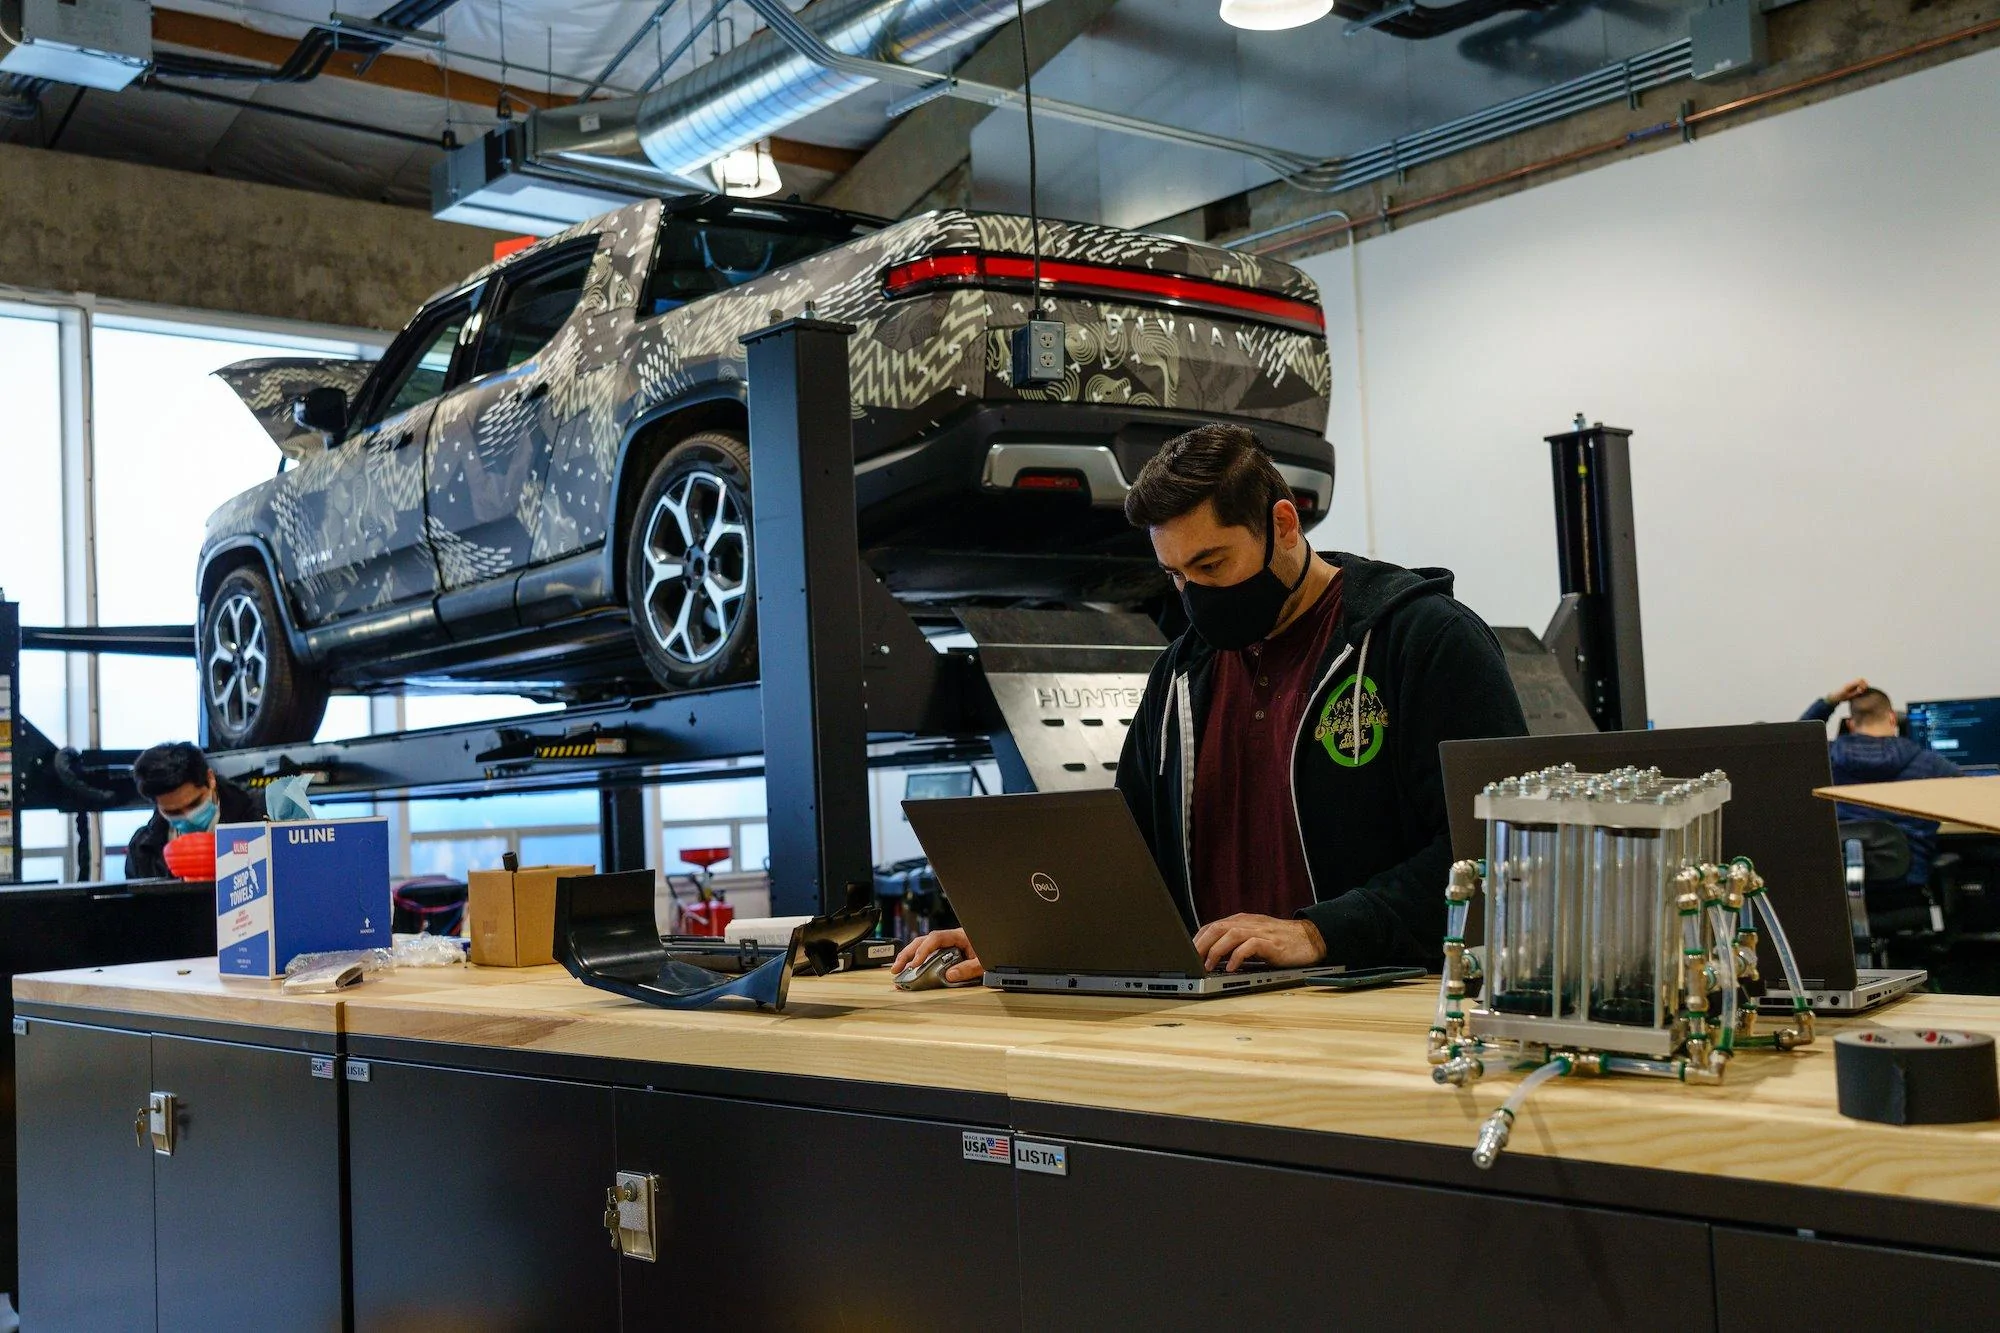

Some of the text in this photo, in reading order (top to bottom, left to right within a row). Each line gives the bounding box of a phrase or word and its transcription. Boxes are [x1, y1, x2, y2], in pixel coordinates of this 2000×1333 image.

[1034, 688, 1145, 709] HUNTE
[288, 827, 336, 845] ULINE
[233, 842, 248, 853] ULINE
[233, 870, 250, 891] SHOP
[1035, 883, 1057, 892] DELL
[229, 884, 254, 907] TOWELS
[965, 1140, 988, 1153] USA
[1018, 1149, 1057, 1166] LISTA
